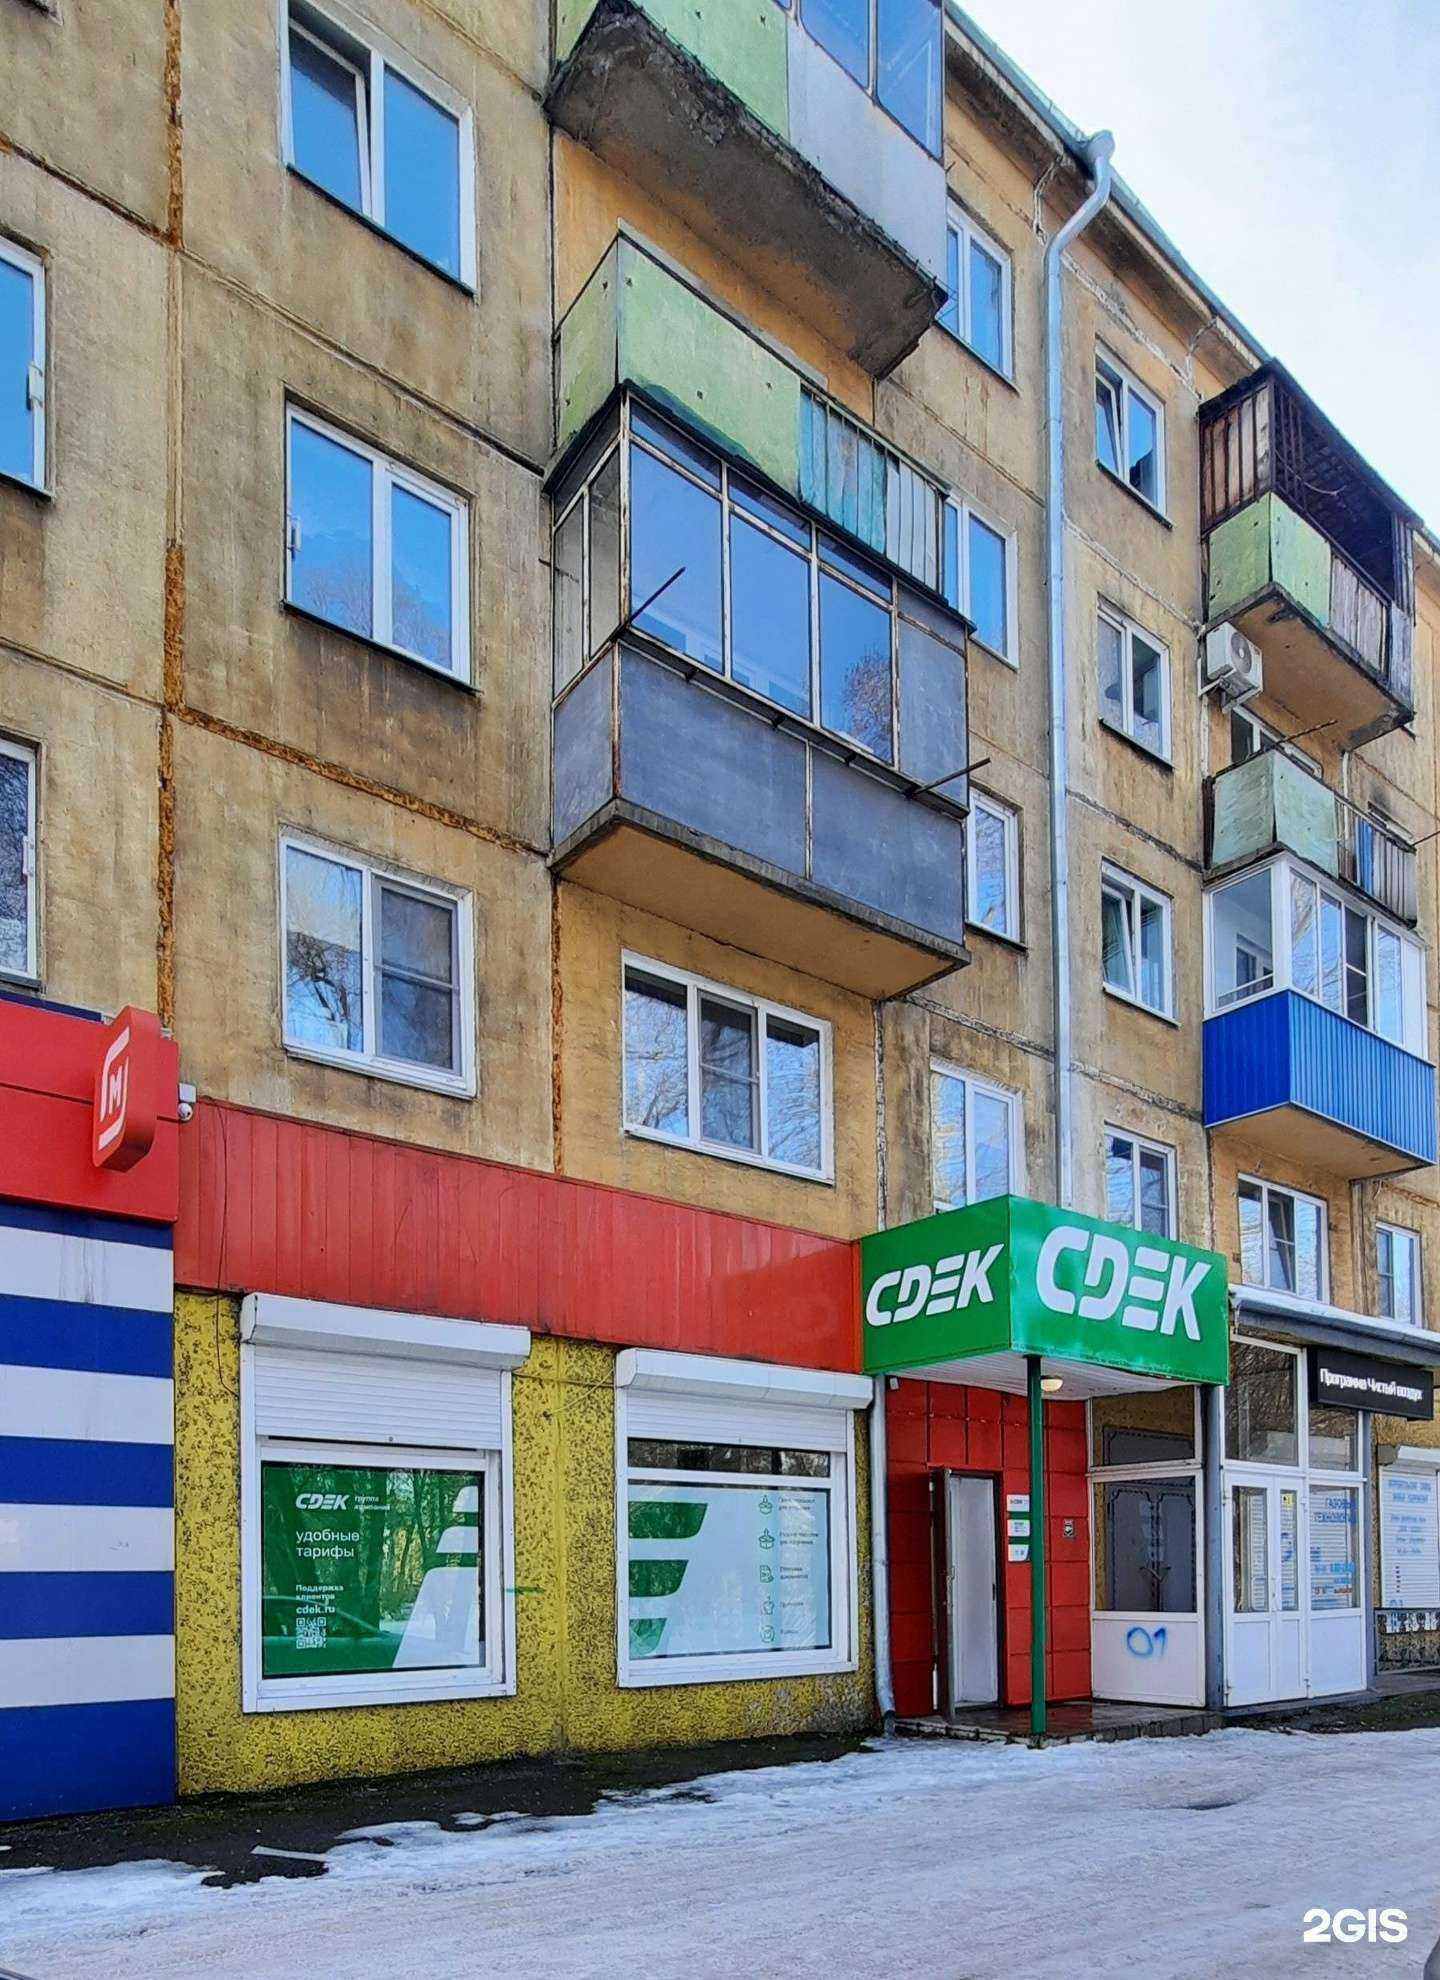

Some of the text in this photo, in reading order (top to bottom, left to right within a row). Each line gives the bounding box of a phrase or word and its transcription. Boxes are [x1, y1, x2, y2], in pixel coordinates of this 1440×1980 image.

[865, 1243, 1005, 1327] CDEK
[1036, 1226, 1213, 1341] CDEK
[1320, 1368, 1367, 1389] Программа
[1367, 1377, 1396, 1396] Чистый
[295, 1493, 350, 1510] CDEK
[296, 1529, 360, 1544] удобные
[296, 1545, 354, 1559] тарифы
[296, 1604, 336, 1613] cdek.ru
